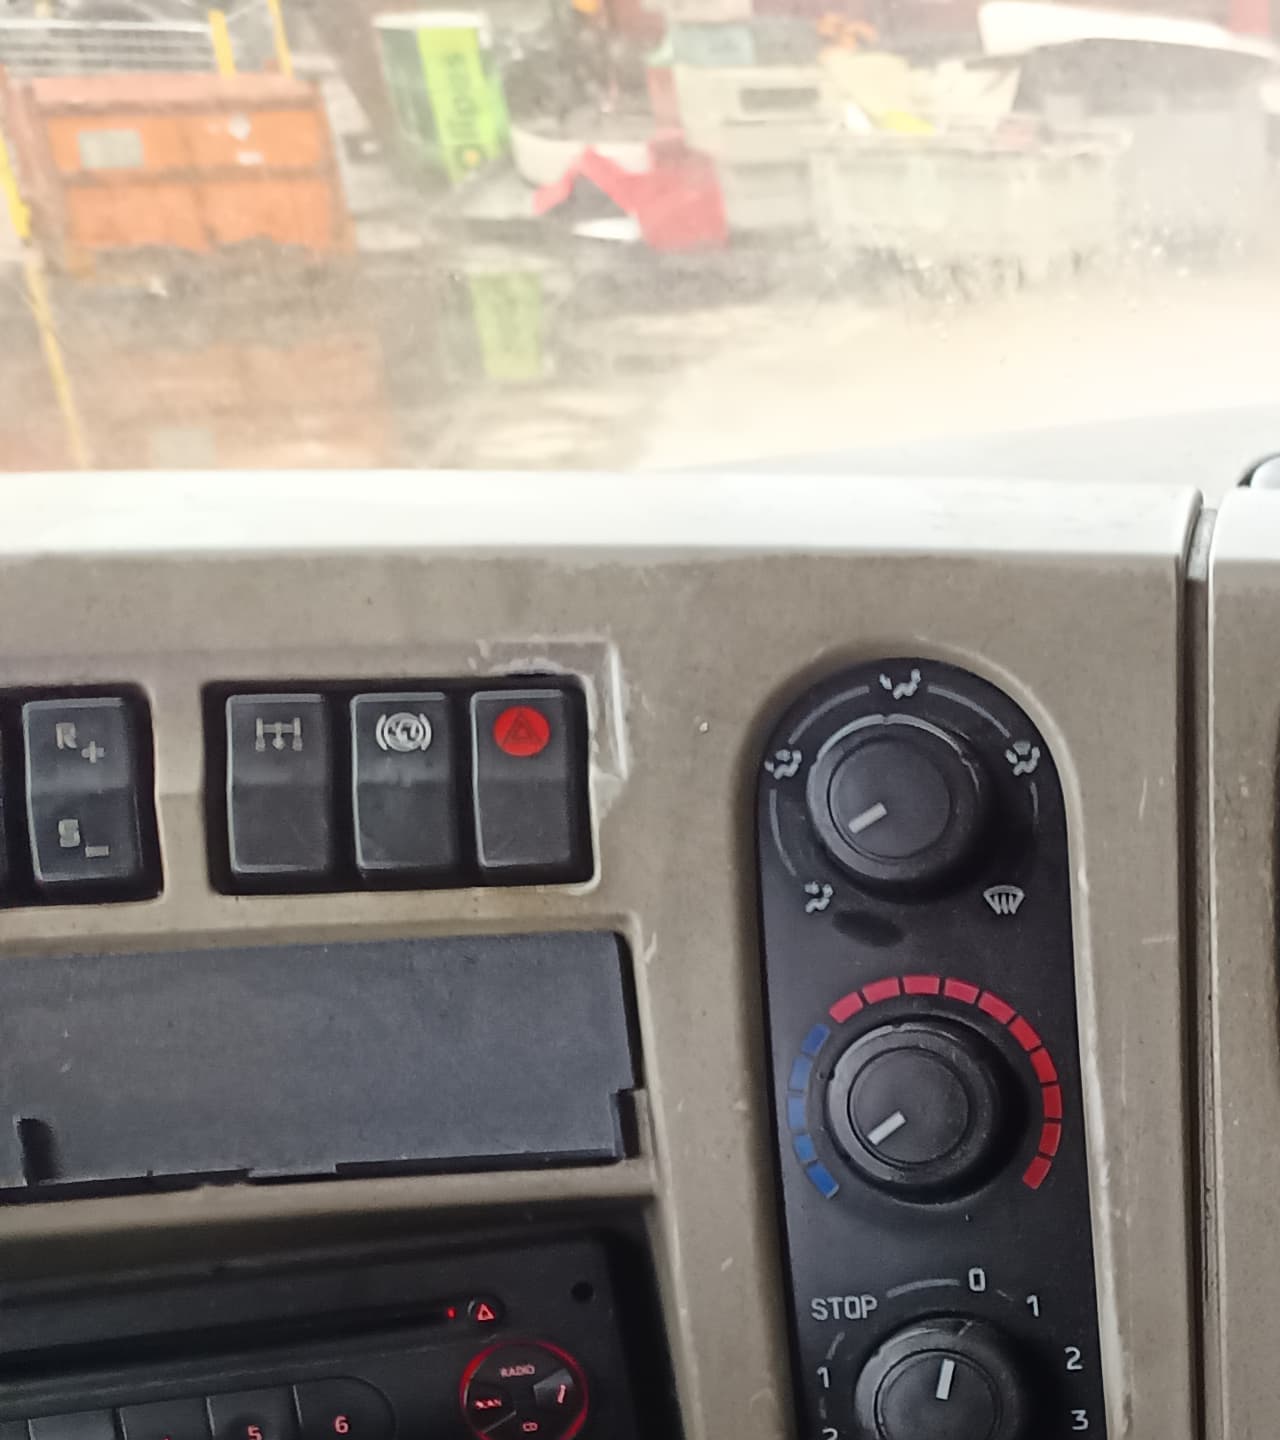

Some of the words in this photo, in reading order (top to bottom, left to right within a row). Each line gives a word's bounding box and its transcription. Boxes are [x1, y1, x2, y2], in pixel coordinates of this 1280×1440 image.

[968, 1268, 986, 1292] 0
[811, 1295, 878, 1321] STOP
[1026, 1296, 1040, 1317] 1
[1065, 1347, 1083, 1370] 2
[501, 1364, 535, 1377] RADIO
[817, 1367, 830, 1387] 1
[334, 1416, 349, 1434] 6
[523, 1422, 538, 1432] CD
[1071, 1410, 1089, 1430] 3
